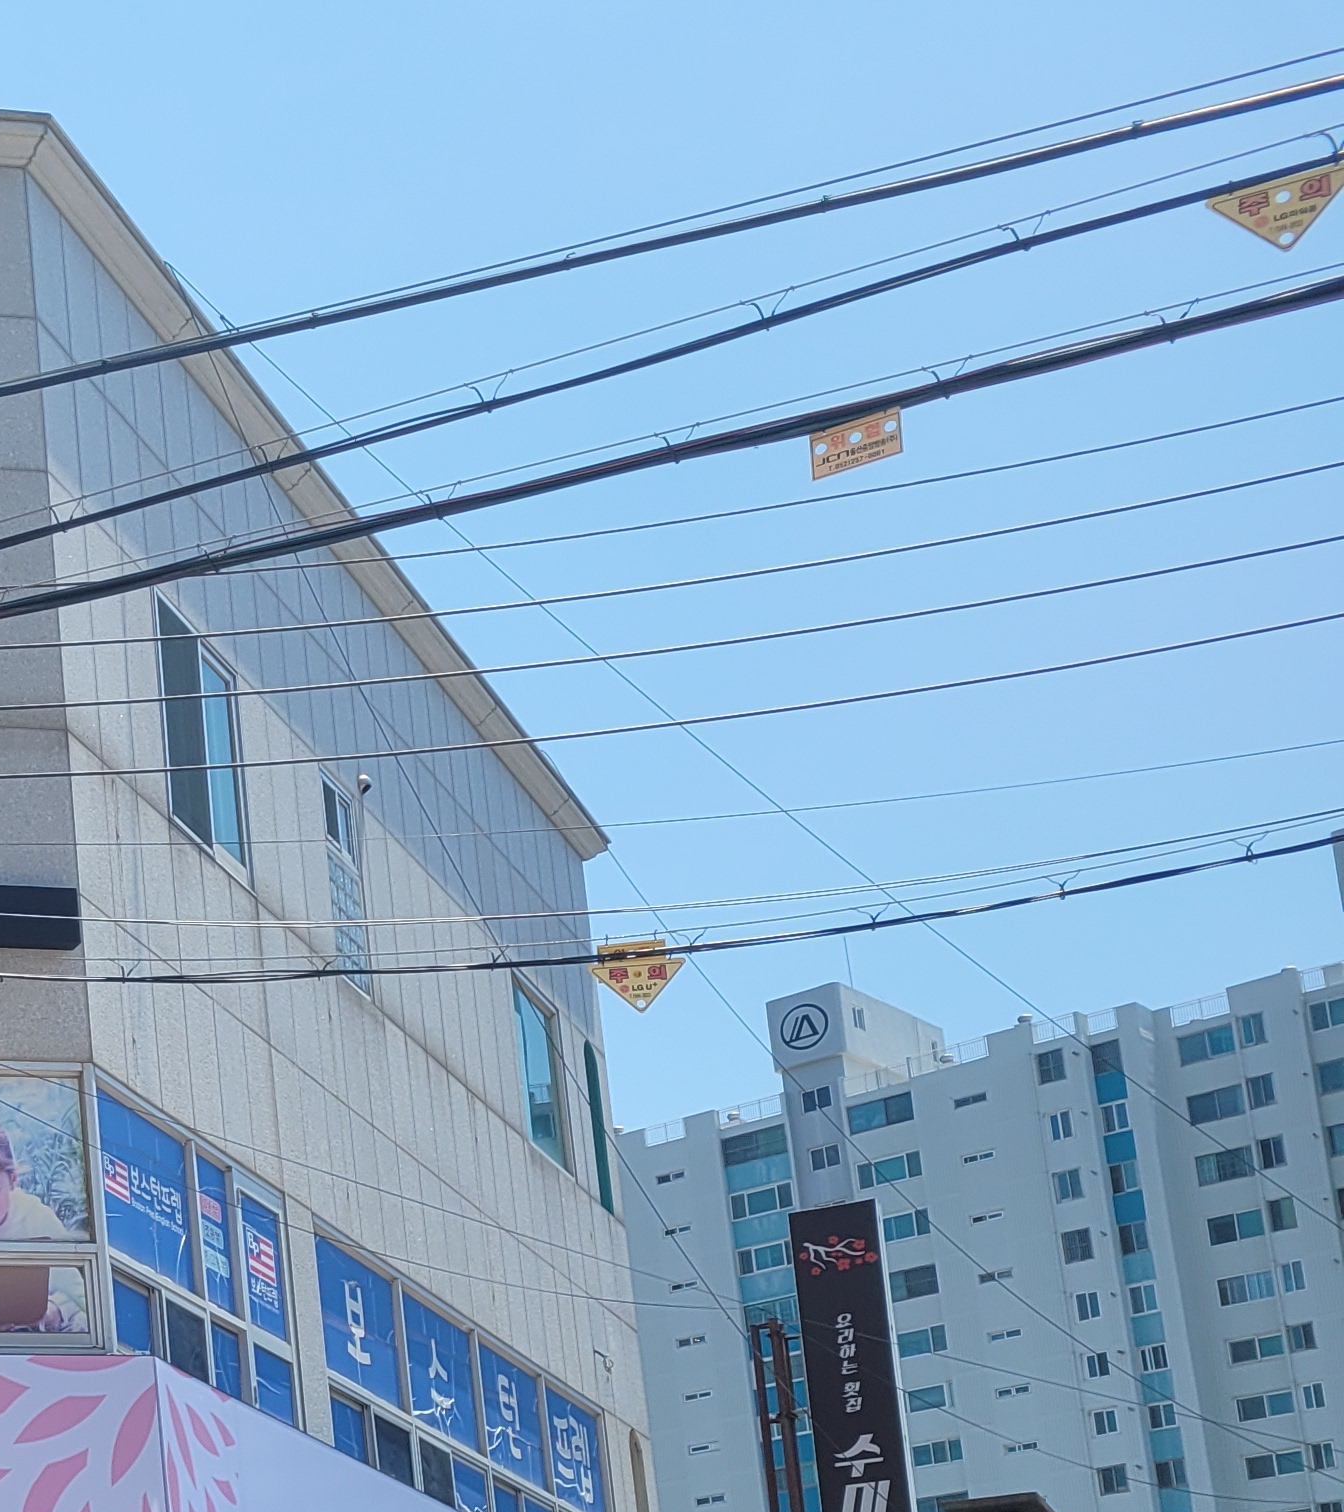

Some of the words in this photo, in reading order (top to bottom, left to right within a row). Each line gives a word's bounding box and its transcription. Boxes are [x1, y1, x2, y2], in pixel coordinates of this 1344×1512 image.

[608, 965, 668, 984] 주의
[130, 1163, 183, 1226] 보스턴프렙
[834, 1312, 860, 1376] 요리하는
[842, 1380, 863, 1414] 횟집
